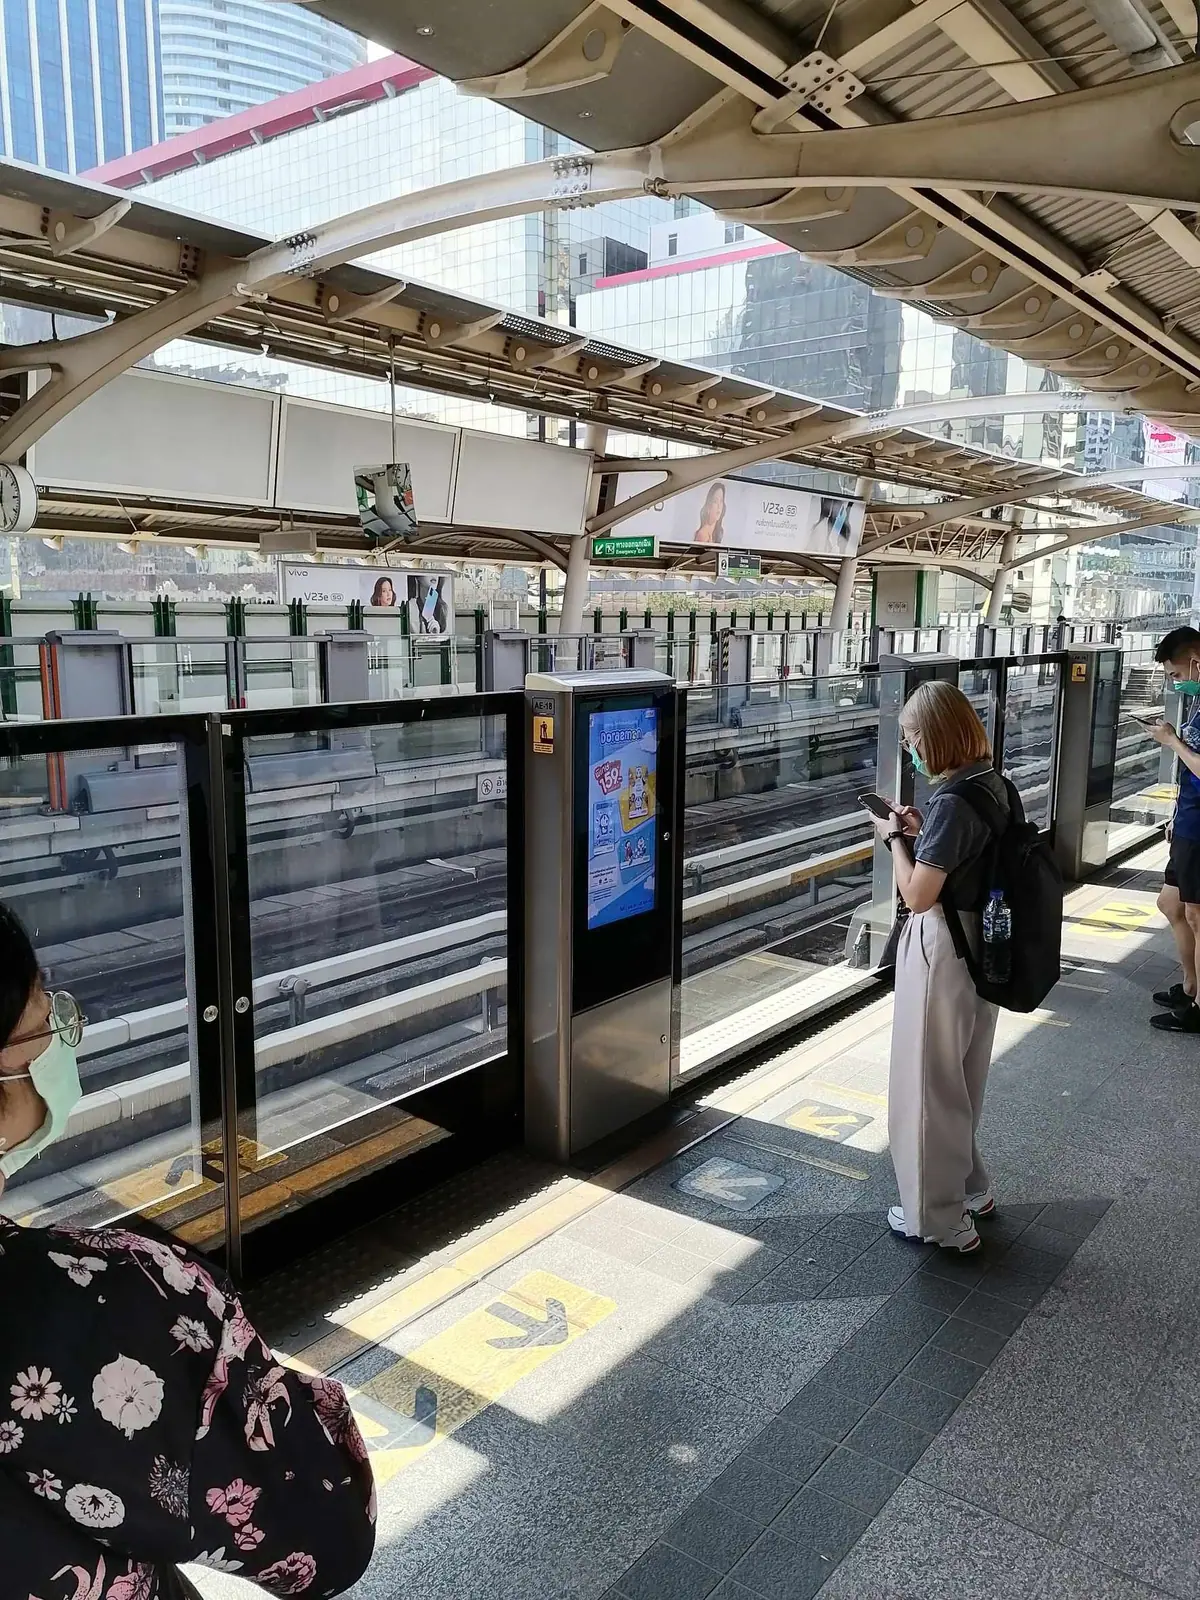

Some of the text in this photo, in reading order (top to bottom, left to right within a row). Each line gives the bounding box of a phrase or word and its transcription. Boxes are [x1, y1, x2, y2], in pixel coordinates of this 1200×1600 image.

[762, 501, 784, 515] V23e
[615, 538, 651, 548] ทางออกฉุกเฉิน
[615, 548, 637, 556] Emergency
[304, 592, 328, 601] V23e
[534, 701, 553, 710] AE-18
[599, 728, 643, 744] Doraemon
